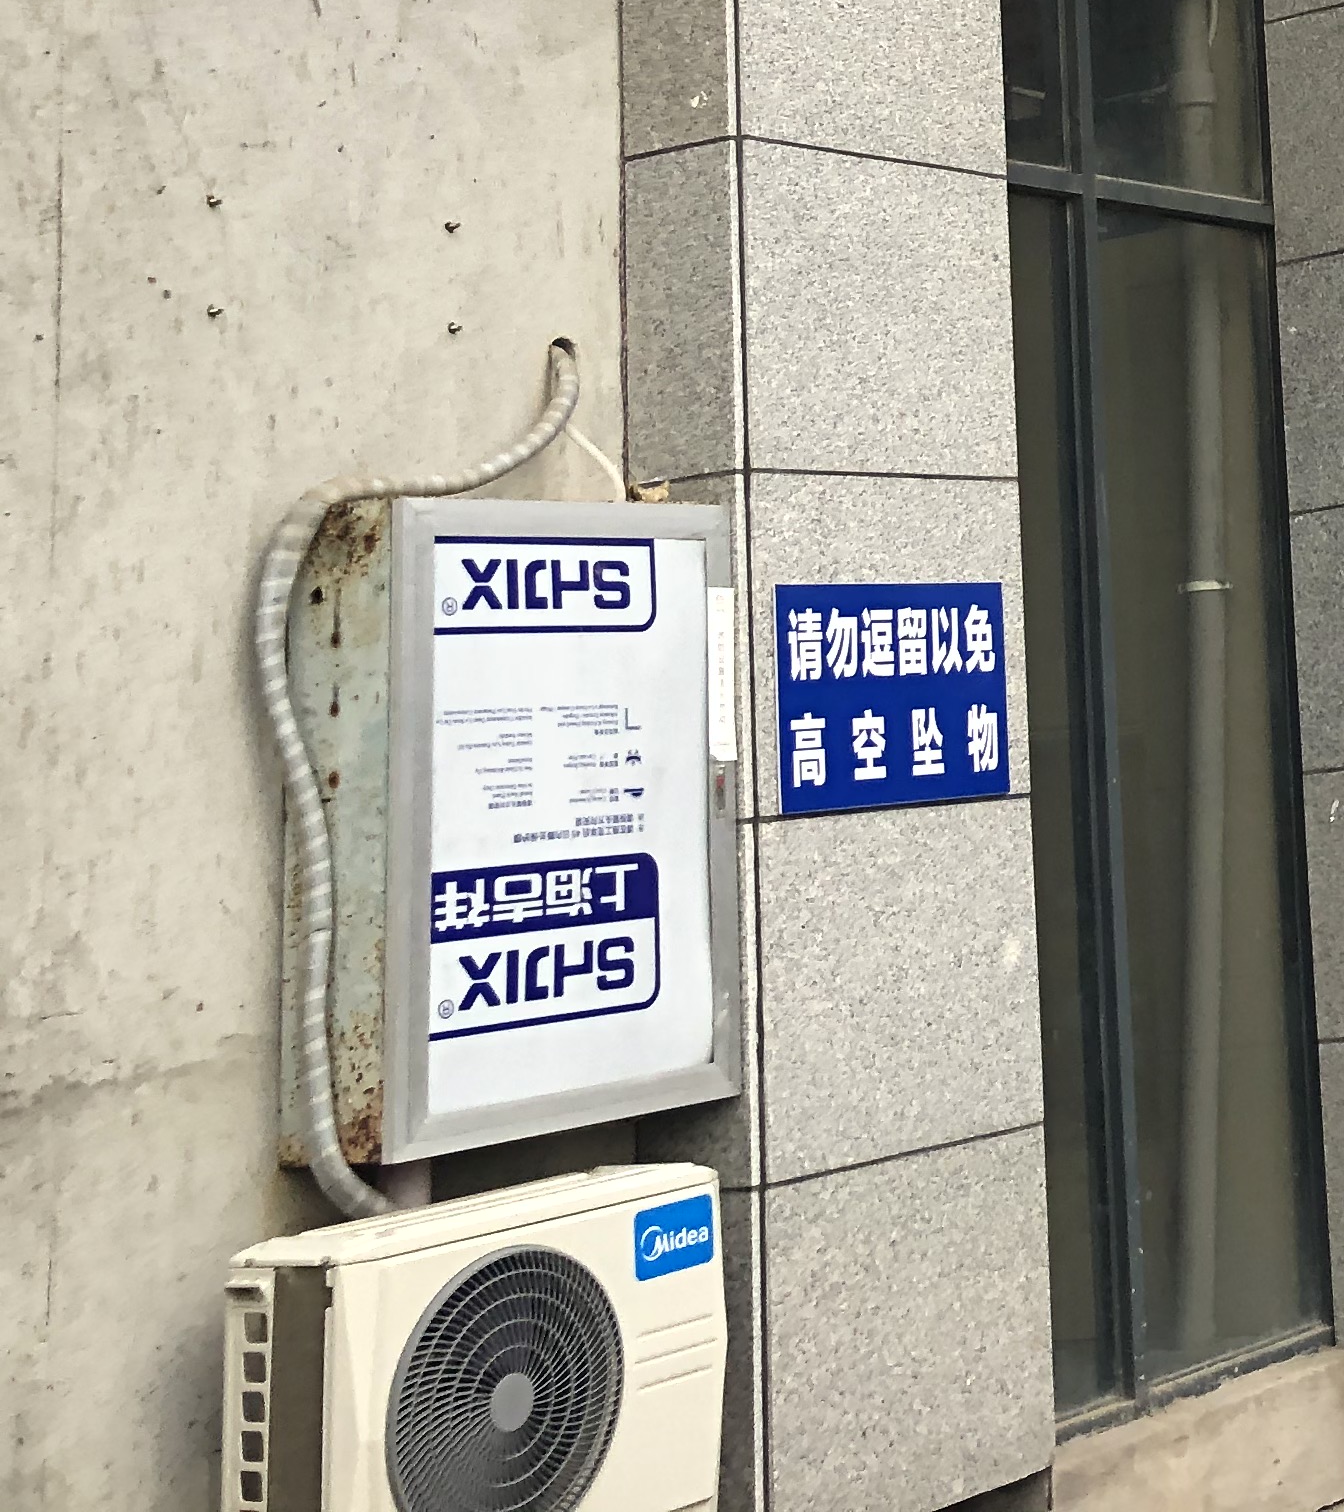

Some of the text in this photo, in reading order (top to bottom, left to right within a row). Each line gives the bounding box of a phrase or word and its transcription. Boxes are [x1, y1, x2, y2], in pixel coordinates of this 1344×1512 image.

[461, 558, 631, 611] SHJIX
[788, 603, 996, 682] 请勿逗留以免
[790, 703, 999, 788] 高空坠物
[434, 862, 639, 932] 上海吉祥
[457, 936, 635, 1012] SHJIX
[641, 1225, 709, 1262] Midea
